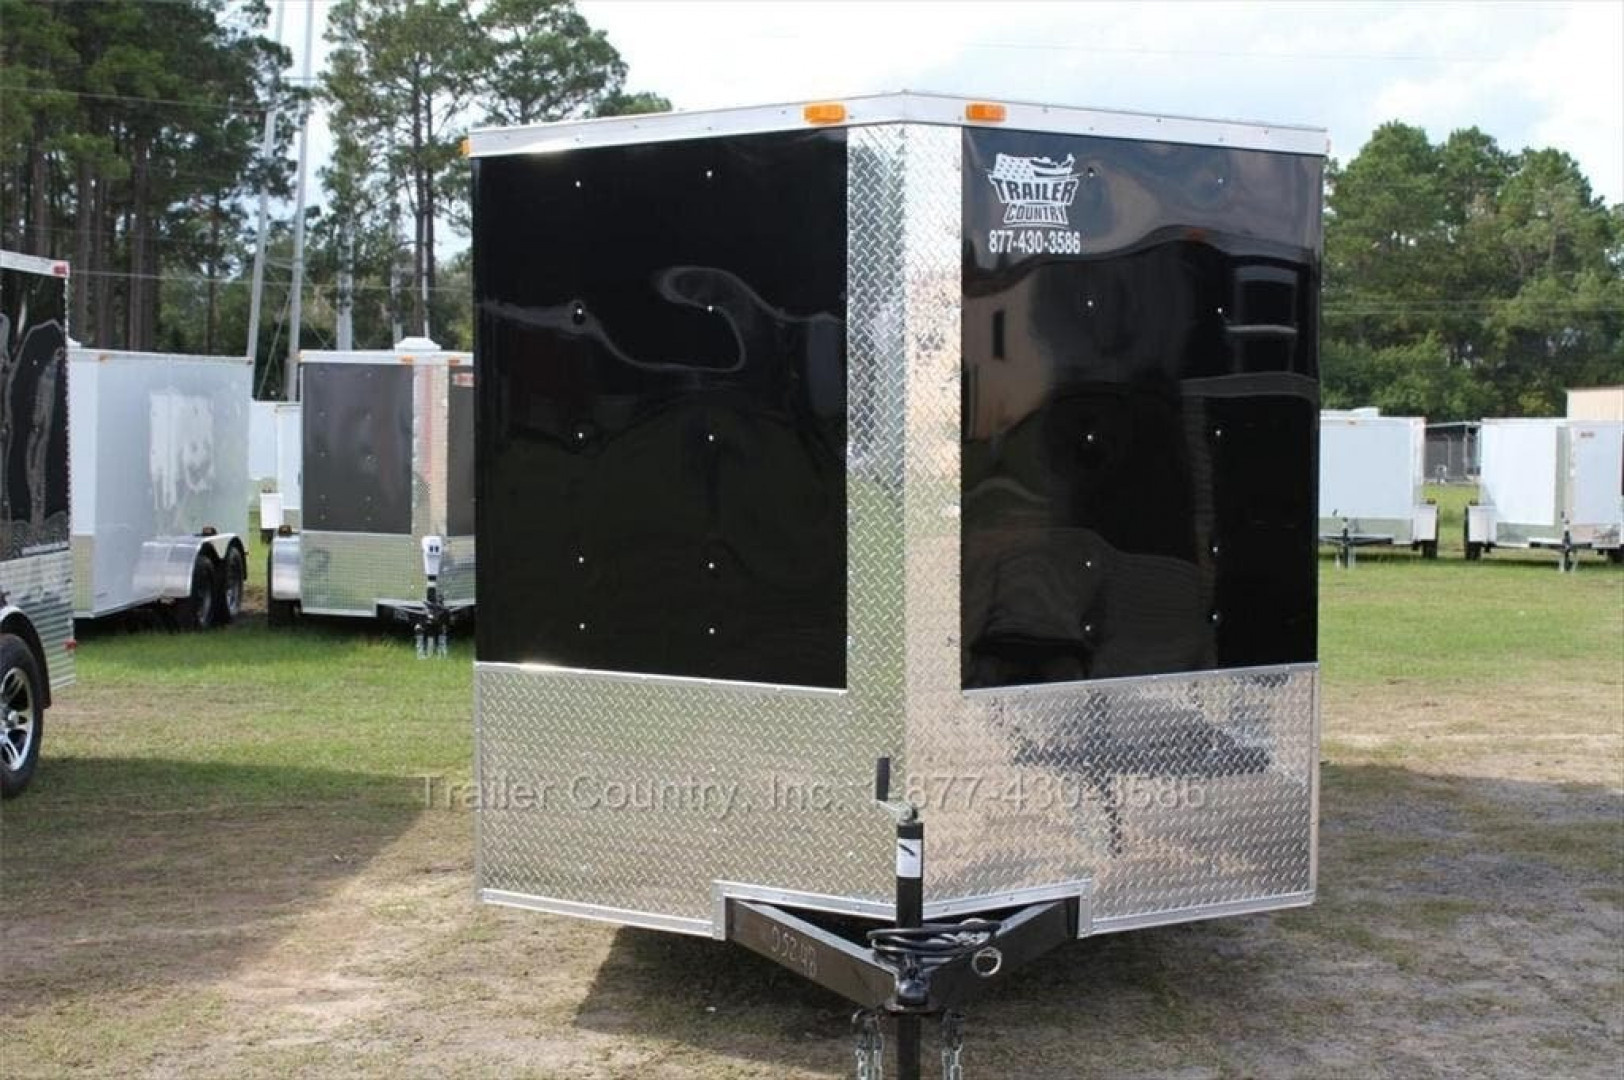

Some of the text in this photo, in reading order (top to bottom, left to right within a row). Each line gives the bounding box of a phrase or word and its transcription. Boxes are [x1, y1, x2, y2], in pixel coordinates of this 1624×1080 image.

[987, 174, 1079, 205] TRAILER
[1003, 203, 1068, 224] COUNTRY
[989, 229, 1081, 254] 877-430-3586
